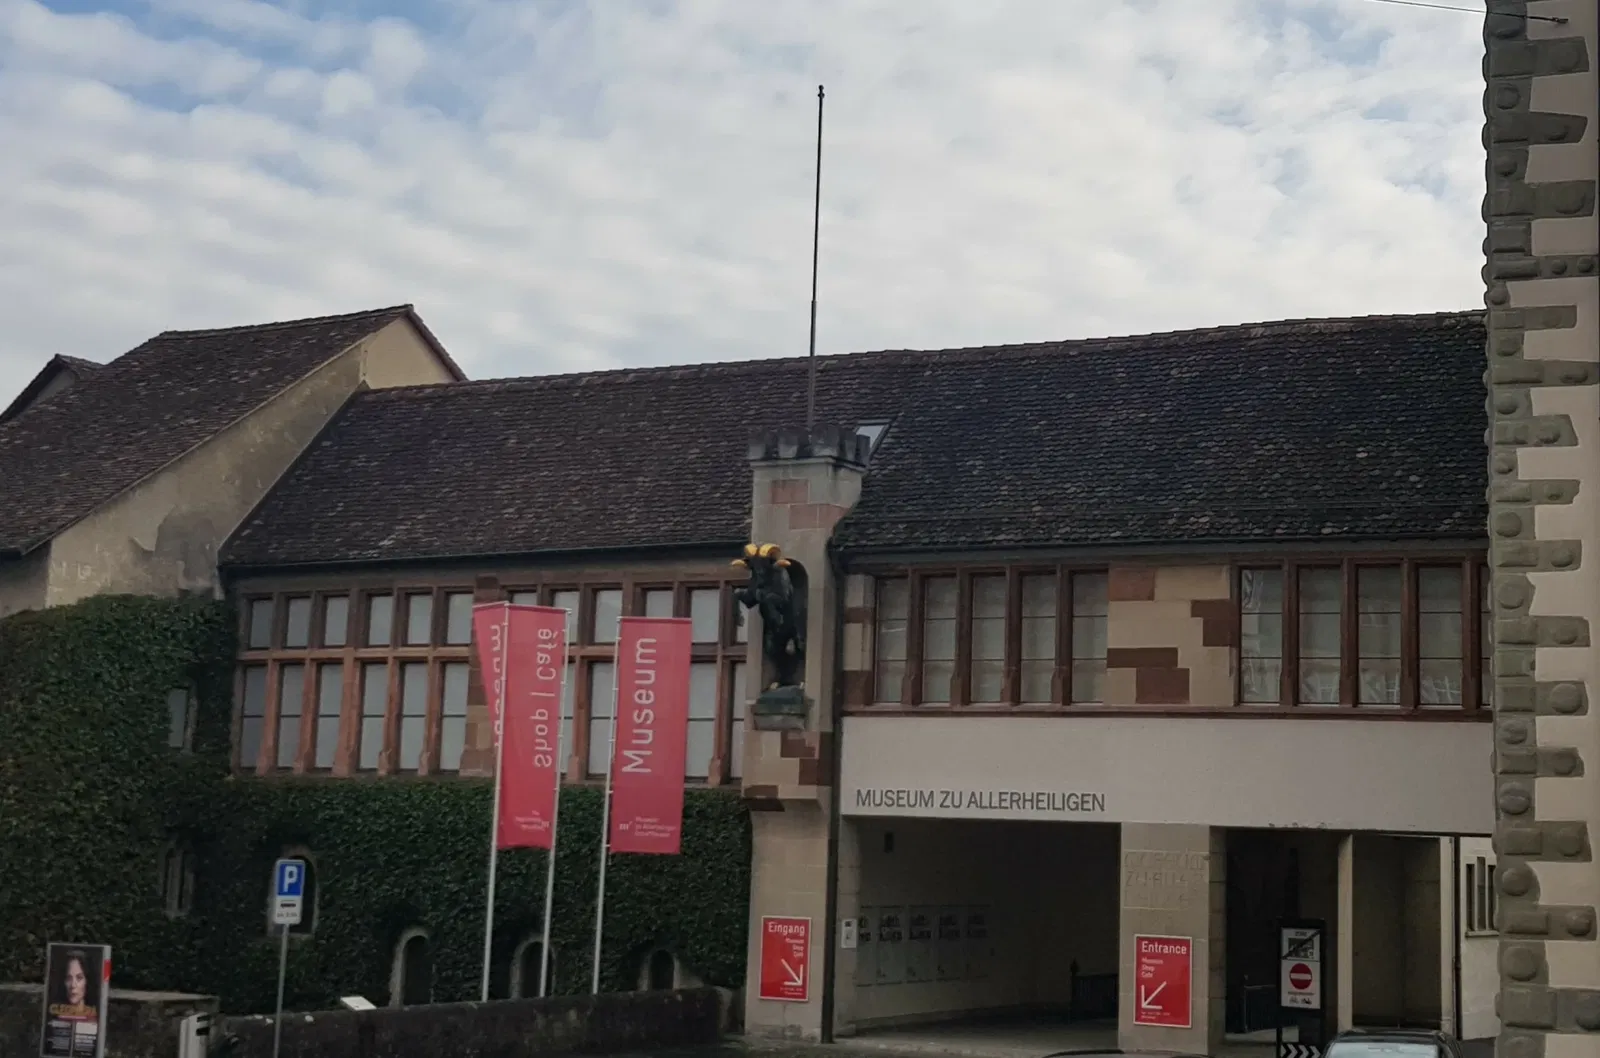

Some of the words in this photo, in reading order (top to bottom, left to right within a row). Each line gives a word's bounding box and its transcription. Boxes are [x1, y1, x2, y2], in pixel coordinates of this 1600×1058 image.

[622, 637, 657, 773] Museum
[856, 789, 934, 808] MUSEUM
[939, 790, 963, 809] ZU
[967, 791, 1105, 812] ALLERHEILIGEN
[283, 865, 298, 893] P
[768, 921, 805, 937] Eingang
[1142, 941, 1187, 954] Entrance
